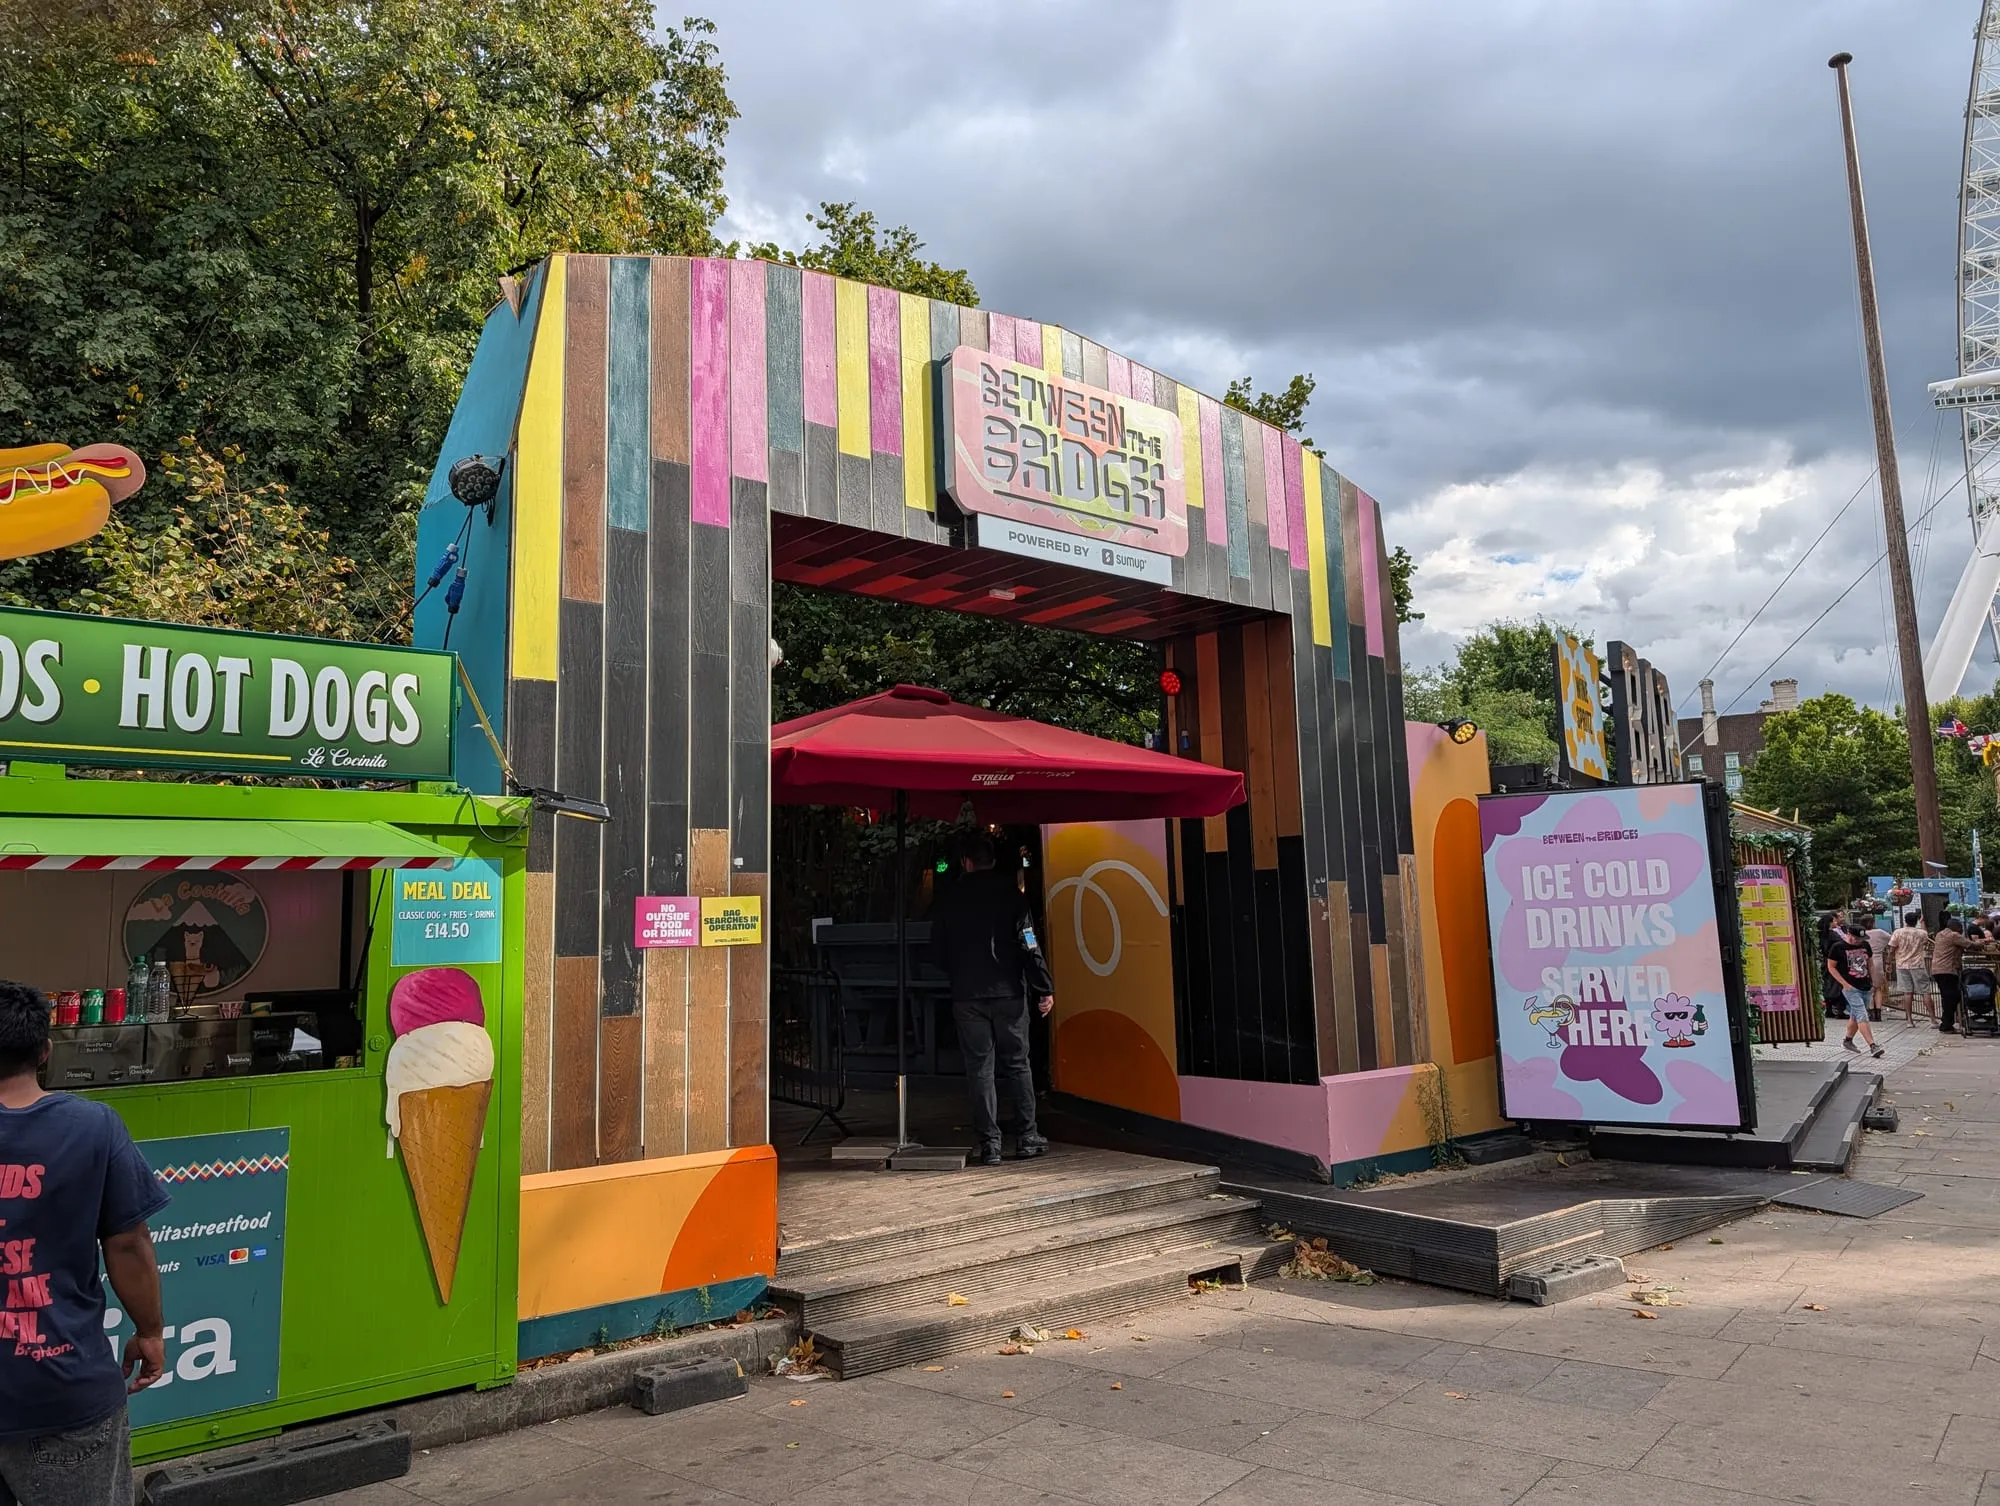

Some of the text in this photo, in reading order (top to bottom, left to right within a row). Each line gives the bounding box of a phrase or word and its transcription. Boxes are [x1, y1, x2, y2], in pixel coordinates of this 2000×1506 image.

[981, 362, 1126, 449] BETWEEN
[984, 415, 1165, 520] BRIDGES
[1008, 530, 1071, 553] POWERED
[1074, 545, 1090, 557] BY
[118, 644, 253, 734] HOT
[268, 658, 420, 745] DOGS
[301, 746, 389, 768] La Cocinita
[1542, 833, 1585, 844] BETWEEN
[1597, 829, 1639, 841] BRIDGES
[1521, 859, 1671, 900] ICE COLD
[1762, 868, 1783, 879] MENU
[403, 881, 492, 900] MEAL DEAL
[398, 911, 425, 920] CLASSIC
[426, 911, 441, 919] DOG
[449, 911, 467, 919] FRIES
[475, 910, 495, 919] DRINK
[646, 912, 690, 921] OUTSIDE
[660, 904, 676, 913] NO
[723, 909, 741, 917] BAG
[654, 920, 682, 929] FOOD
[704, 915, 759, 925] SEARCHES IN
[709, 923, 756, 932] OPERATION
[1525, 903, 1676, 949] DRINKS
[425, 922, 470, 939] £14.50
[642, 929, 692, 938] OR DRINK
[1541, 965, 1671, 1003] SERVED
[1568, 1009, 1655, 1047] HERE
[195, 1253, 226, 1267] VISA
